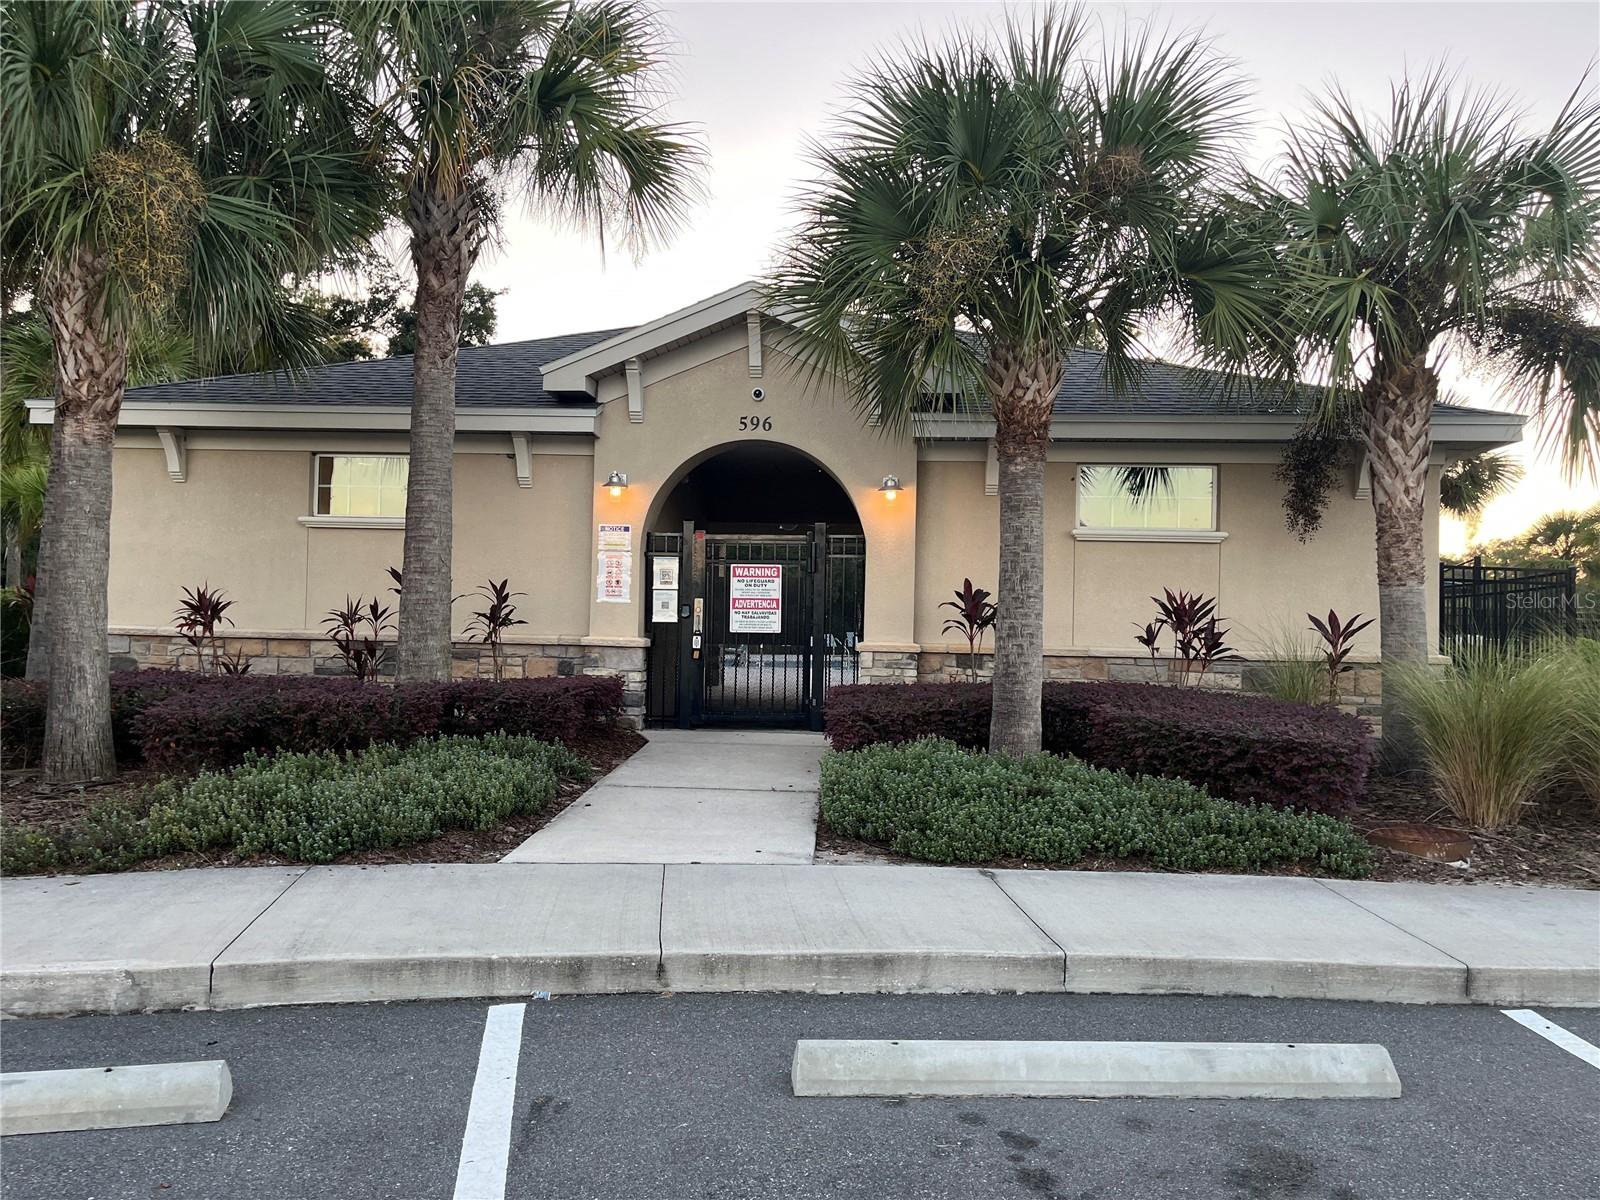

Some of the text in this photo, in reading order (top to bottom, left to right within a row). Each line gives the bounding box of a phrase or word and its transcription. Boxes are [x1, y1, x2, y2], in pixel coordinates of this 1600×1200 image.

[738, 416, 772, 432] 596
[734, 567, 778, 576] WARNING
[734, 600, 777, 608] ADVERTENCIA
